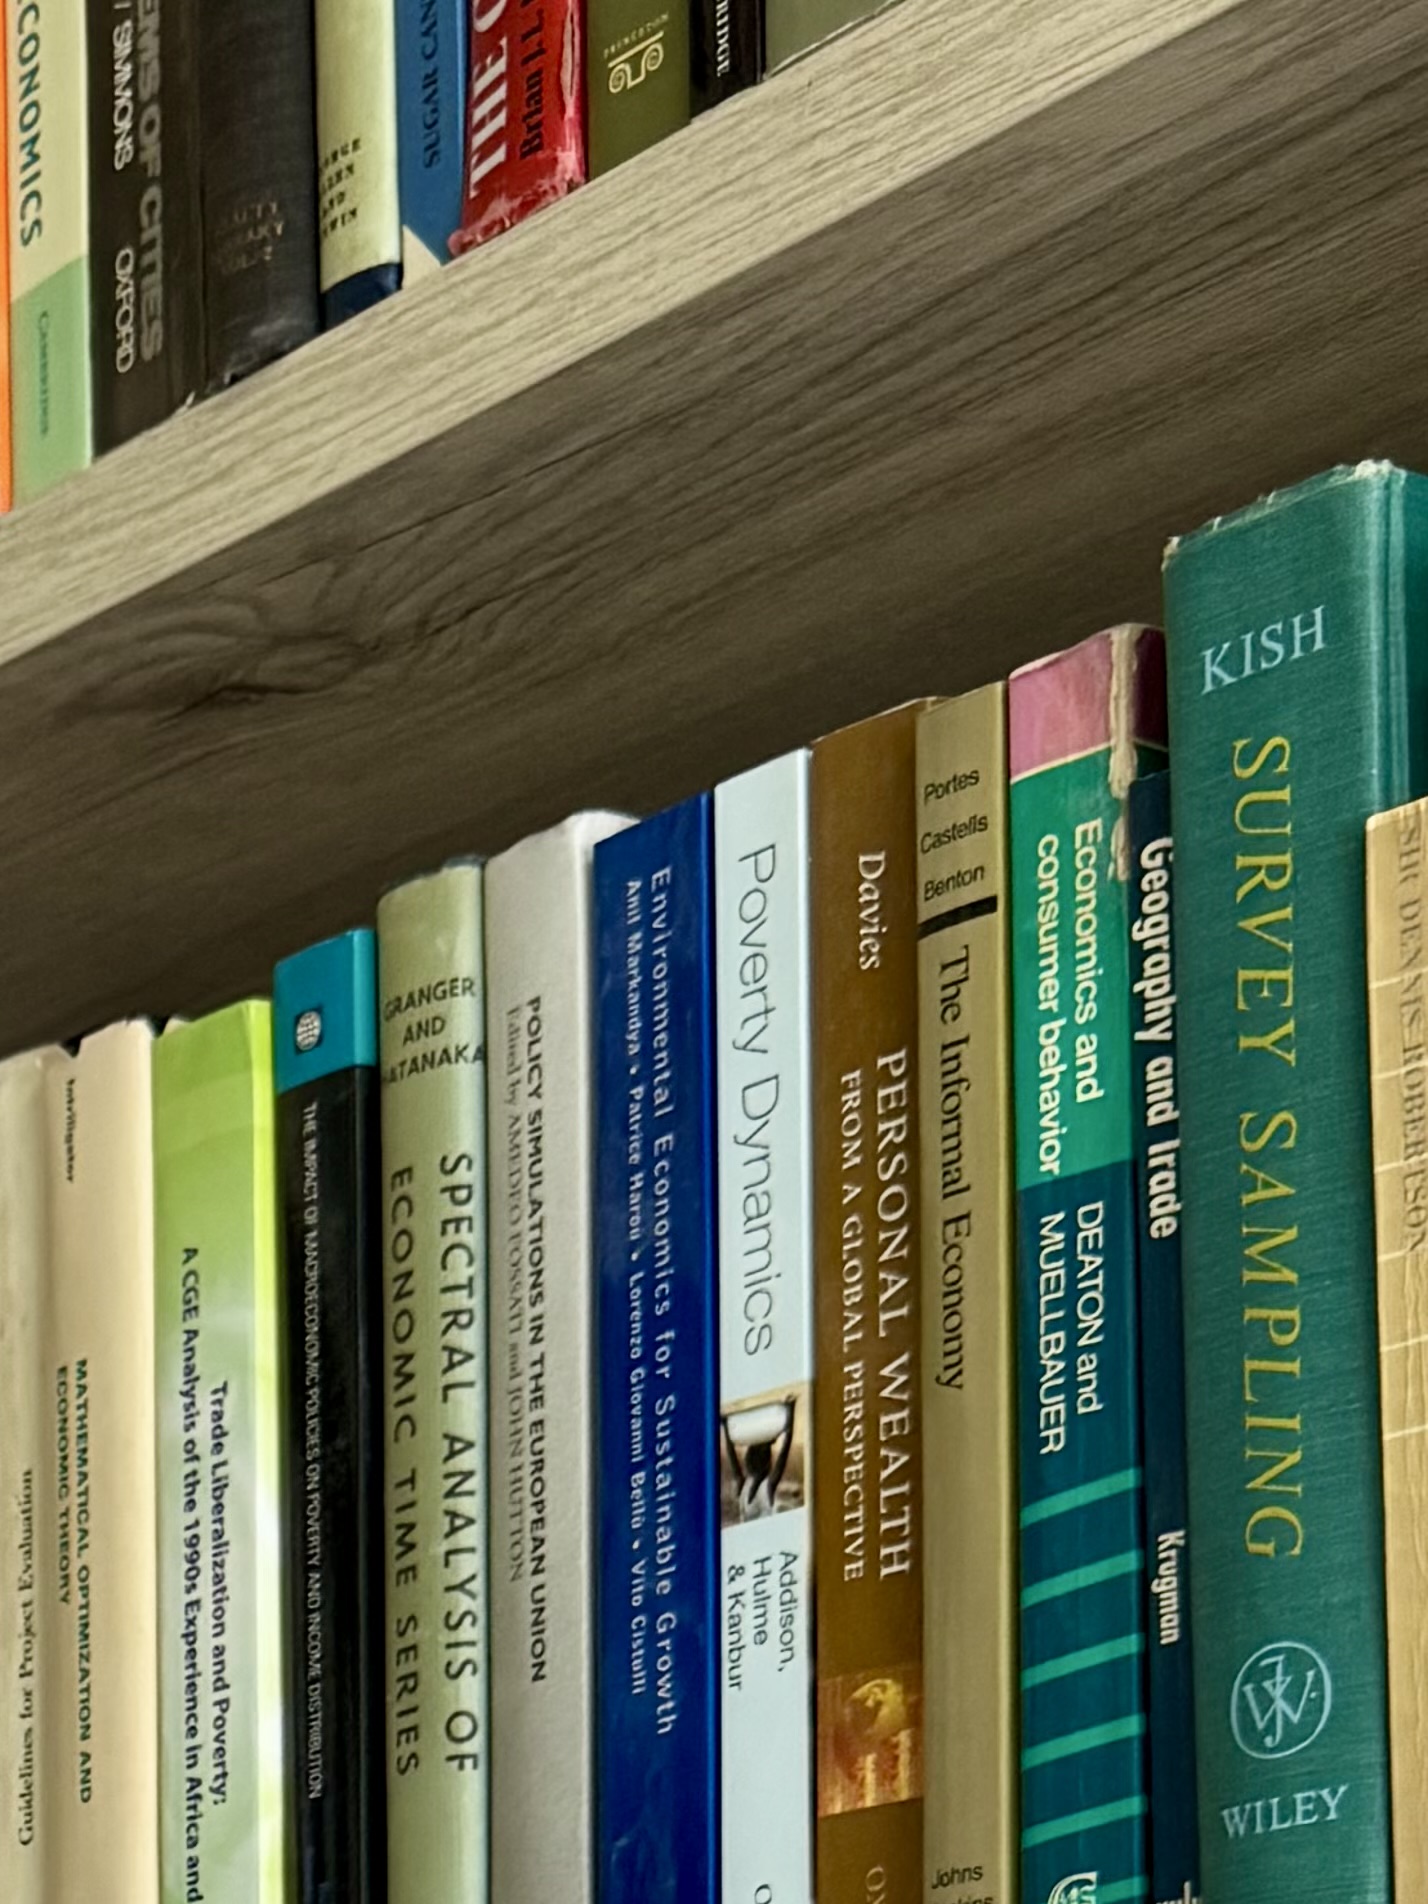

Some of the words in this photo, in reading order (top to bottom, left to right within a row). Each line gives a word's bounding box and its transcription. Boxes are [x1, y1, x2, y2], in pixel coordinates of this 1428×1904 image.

[115, 248, 134, 374] OXFORD
[1200, 605, 1326, 695] KISH
[733, 843, 778, 1054] Poverty
[857, 850, 887, 971] Davies
[1130, 834, 1175, 1045] Geography
[1232, 736, 1297, 1069] SURVEY
[385, 978, 475, 1023] GRANGER
[403, 1016, 446, 1047] AND
[940, 946, 969, 1026] The
[940, 1035, 971, 1206] Informal
[1146, 1055, 1176, 1128] and
[733, 1076, 780, 1356] Dynamics
[877, 1047, 912, 1339] PERSONAL
[1149, 1139, 1182, 1241] Trade
[391, 1167, 418, 1443] ECONOMIC
[440, 1155, 473, 1402] SPECTRAL
[936, 1210, 973, 1392] Economy
[1238, 1112, 1304, 1560] SAMPLING
[394, 1469, 419, 1585] TIME
[878, 1353, 912, 1580] WEALTH
[444, 1433, 477, 1680] ANALYSIS
[1151, 1532, 1185, 1645] Krugman
[395, 1615, 420, 1775] SERIES
[446, 1709, 479, 1773] OF
[1221, 1783, 1349, 1839] WILEY
